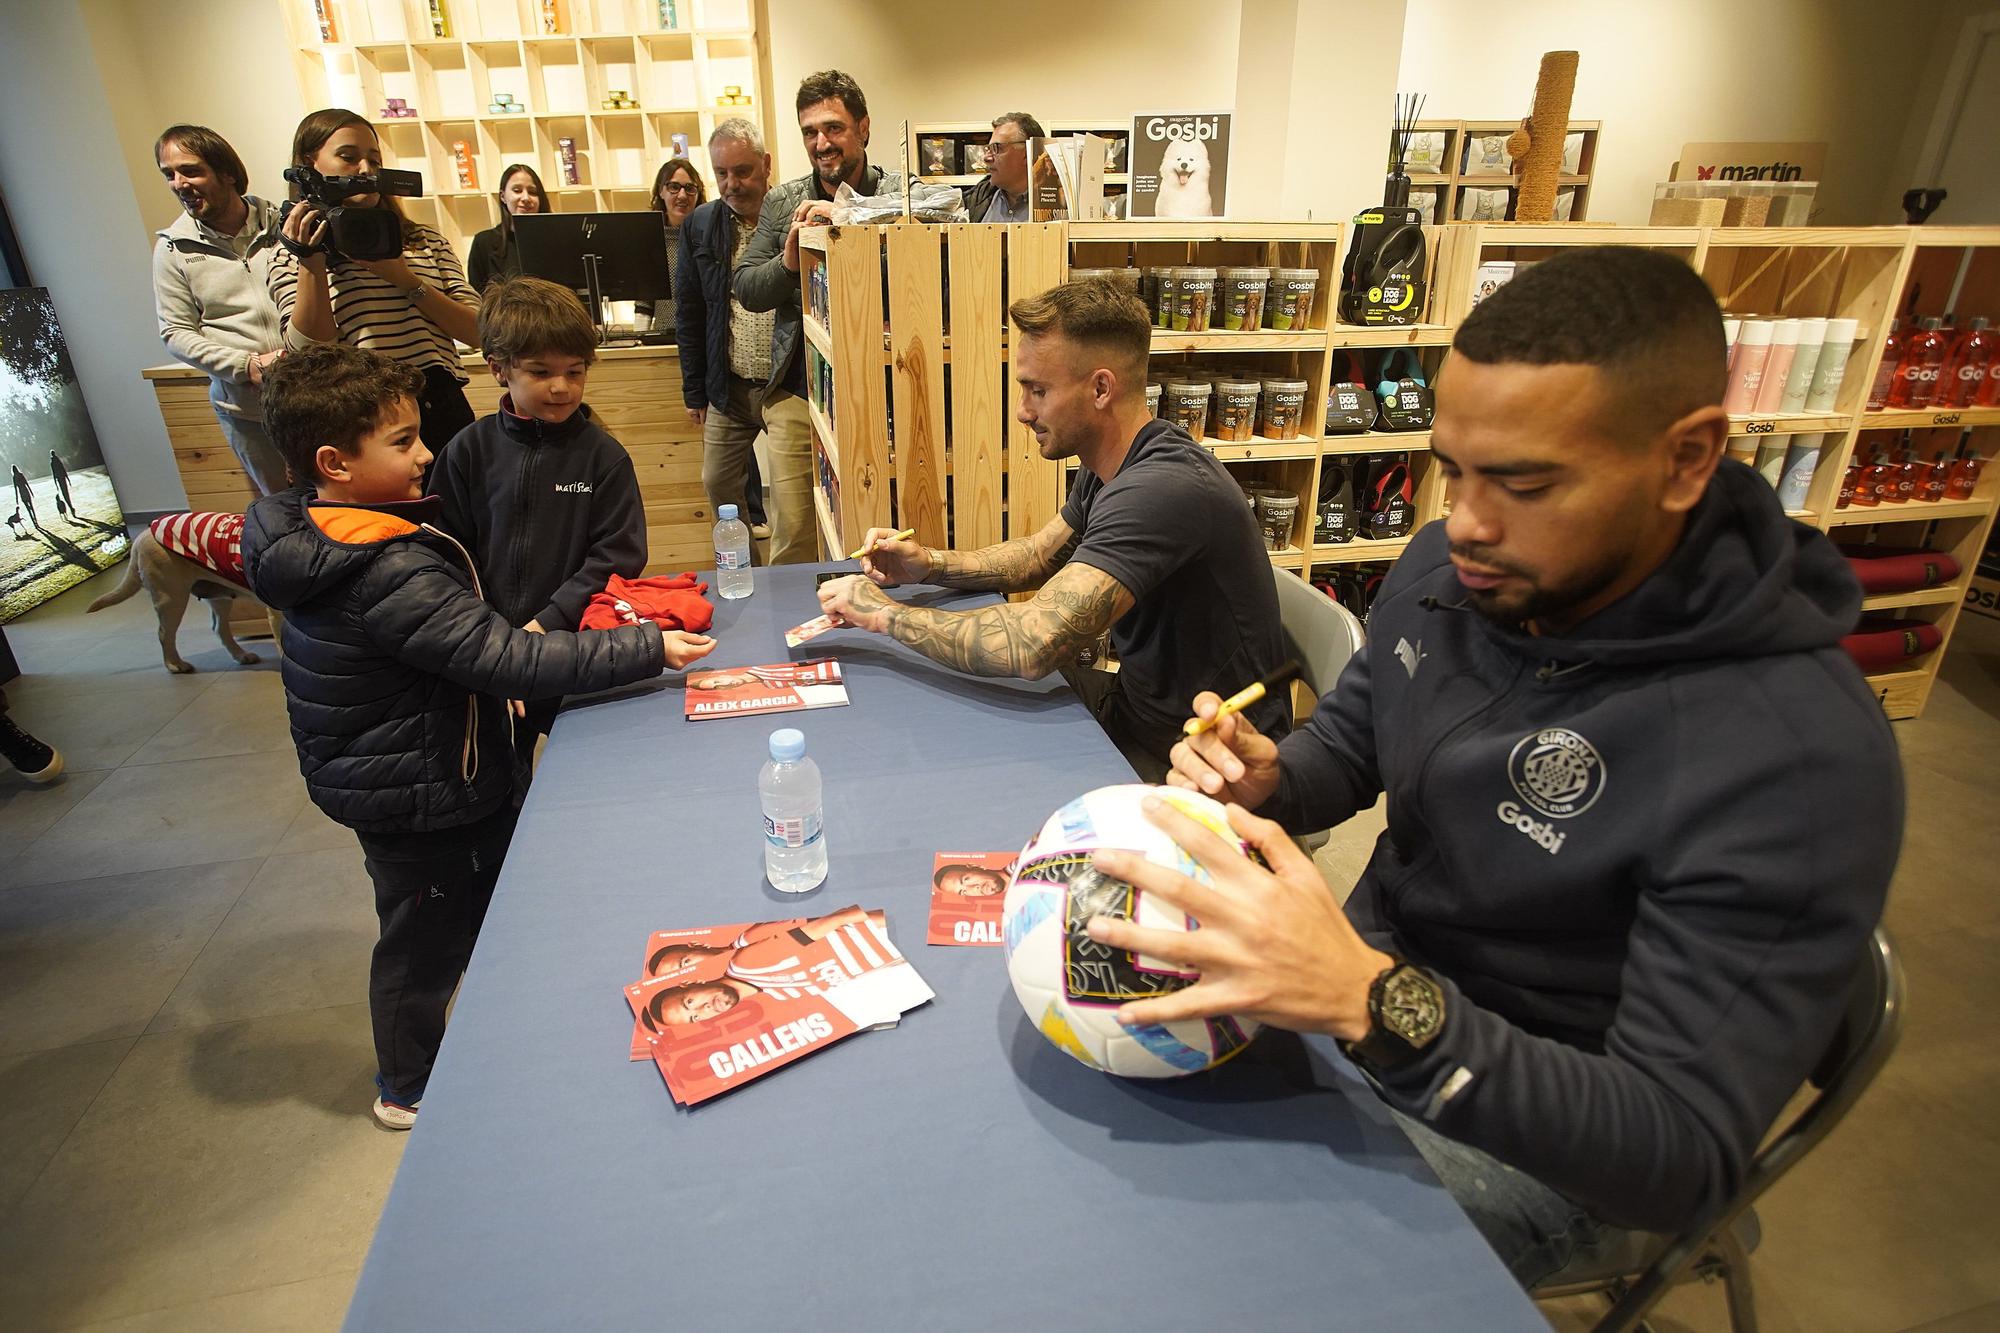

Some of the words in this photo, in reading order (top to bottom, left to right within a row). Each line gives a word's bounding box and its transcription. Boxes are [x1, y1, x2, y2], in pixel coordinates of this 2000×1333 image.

[1145, 116, 1219, 142] Gosbi
[185, 255, 207, 265] PUMA
[1384, 290, 1400, 298] DOG
[1338, 396, 1358, 405] DOG
[1401, 395, 1419, 404] DOG
[1932, 412, 1960, 425] Gosbi
[1745, 421, 1776, 434] Gosbi
[1327, 515, 1344, 523] DOG
[1389, 512, 1403, 520] DOG
[694, 700, 739, 713] ALEIX
[740, 695, 799, 708] GARCIA
[1537, 732, 1597, 769] GIRONA
[1549, 803, 1574, 813] CLUB
[1497, 800, 1567, 855] Gosbi
[708, 1012, 834, 1080] CALLENS
